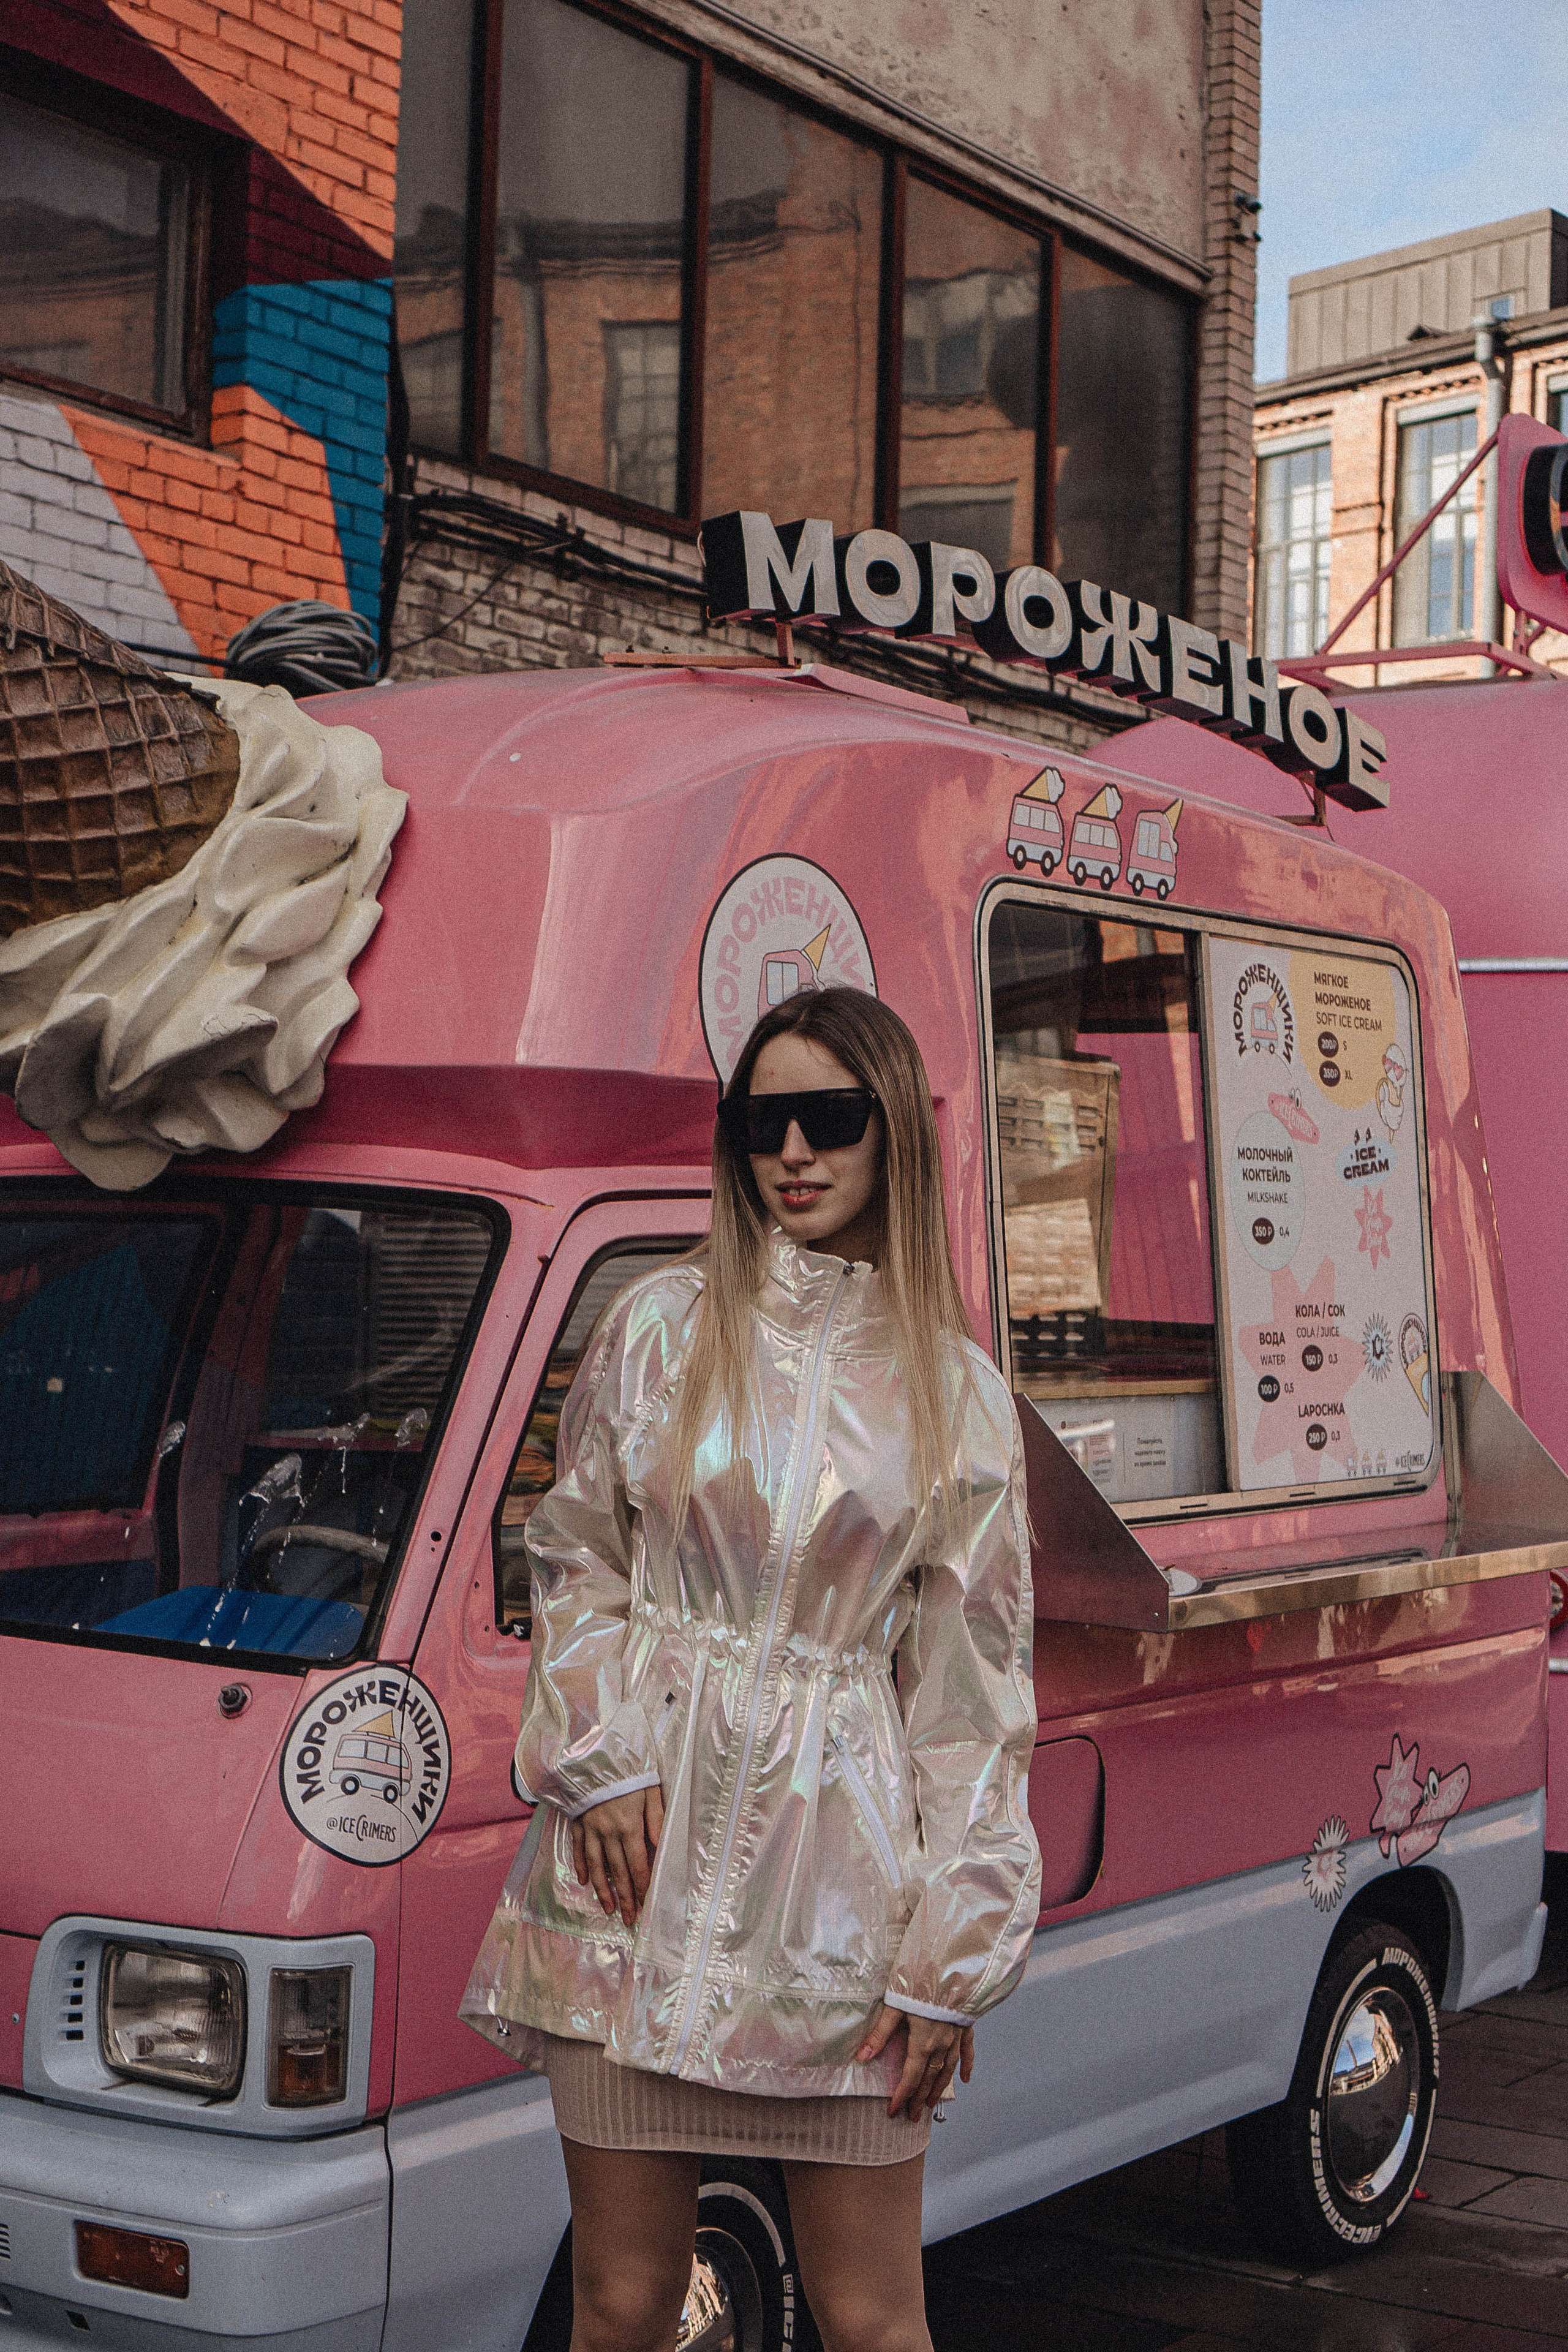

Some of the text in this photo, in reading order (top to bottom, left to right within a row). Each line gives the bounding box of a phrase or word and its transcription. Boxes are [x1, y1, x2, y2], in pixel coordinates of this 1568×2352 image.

[739, 510, 1390, 810] МОРОЖЕНОЕ
[1314, 971, 1349, 988] МЯГКОЕ
[1314, 991, 1371, 1011] МОРОЖЕНОЕ
[1233, 963, 1294, 1065] МОРОЖЕНЩИКИ
[1316, 1012, 1383, 1031] SOFT ICE CREAM
[1343, 1041, 1348, 1051] S
[1344, 1069, 1354, 1080] XL
[1237, 1146, 1294, 1163] МОЛОЧНЫЙ
[1355, 1147, 1376, 1162] ICE
[1242, 1167, 1291, 1184] КОКТЕЙЛЬ
[1343, 1158, 1390, 1180] CREAM
[1247, 1189, 1289, 1204] MILKSHAKE
[1280, 1226, 1290, 1238] 0,4
[1295, 1304, 1320, 1318] КОЛА
[1328, 1303, 1346, 1317] СОК
[1259, 1332, 1286, 1347] ВОДА
[1297, 1327, 1316, 1338] COLA
[1321, 1327, 1340, 1338] JUICE
[1261, 1354, 1286, 1366] WATER
[1329, 1354, 1338, 1365] 0,3
[1284, 1382, 1294, 1394] 0,5
[1298, 1403, 1346, 1419] LAPOCHKA
[1332, 1430, 1340, 1442] 0,3
[296, 1679, 442, 1824] МОРОЖЕНЩИКИ
[326, 1814, 397, 1842] @ICECRIMERS
[1381, 1947, 1439, 2079] МОРОЖЕНЩИКИ
